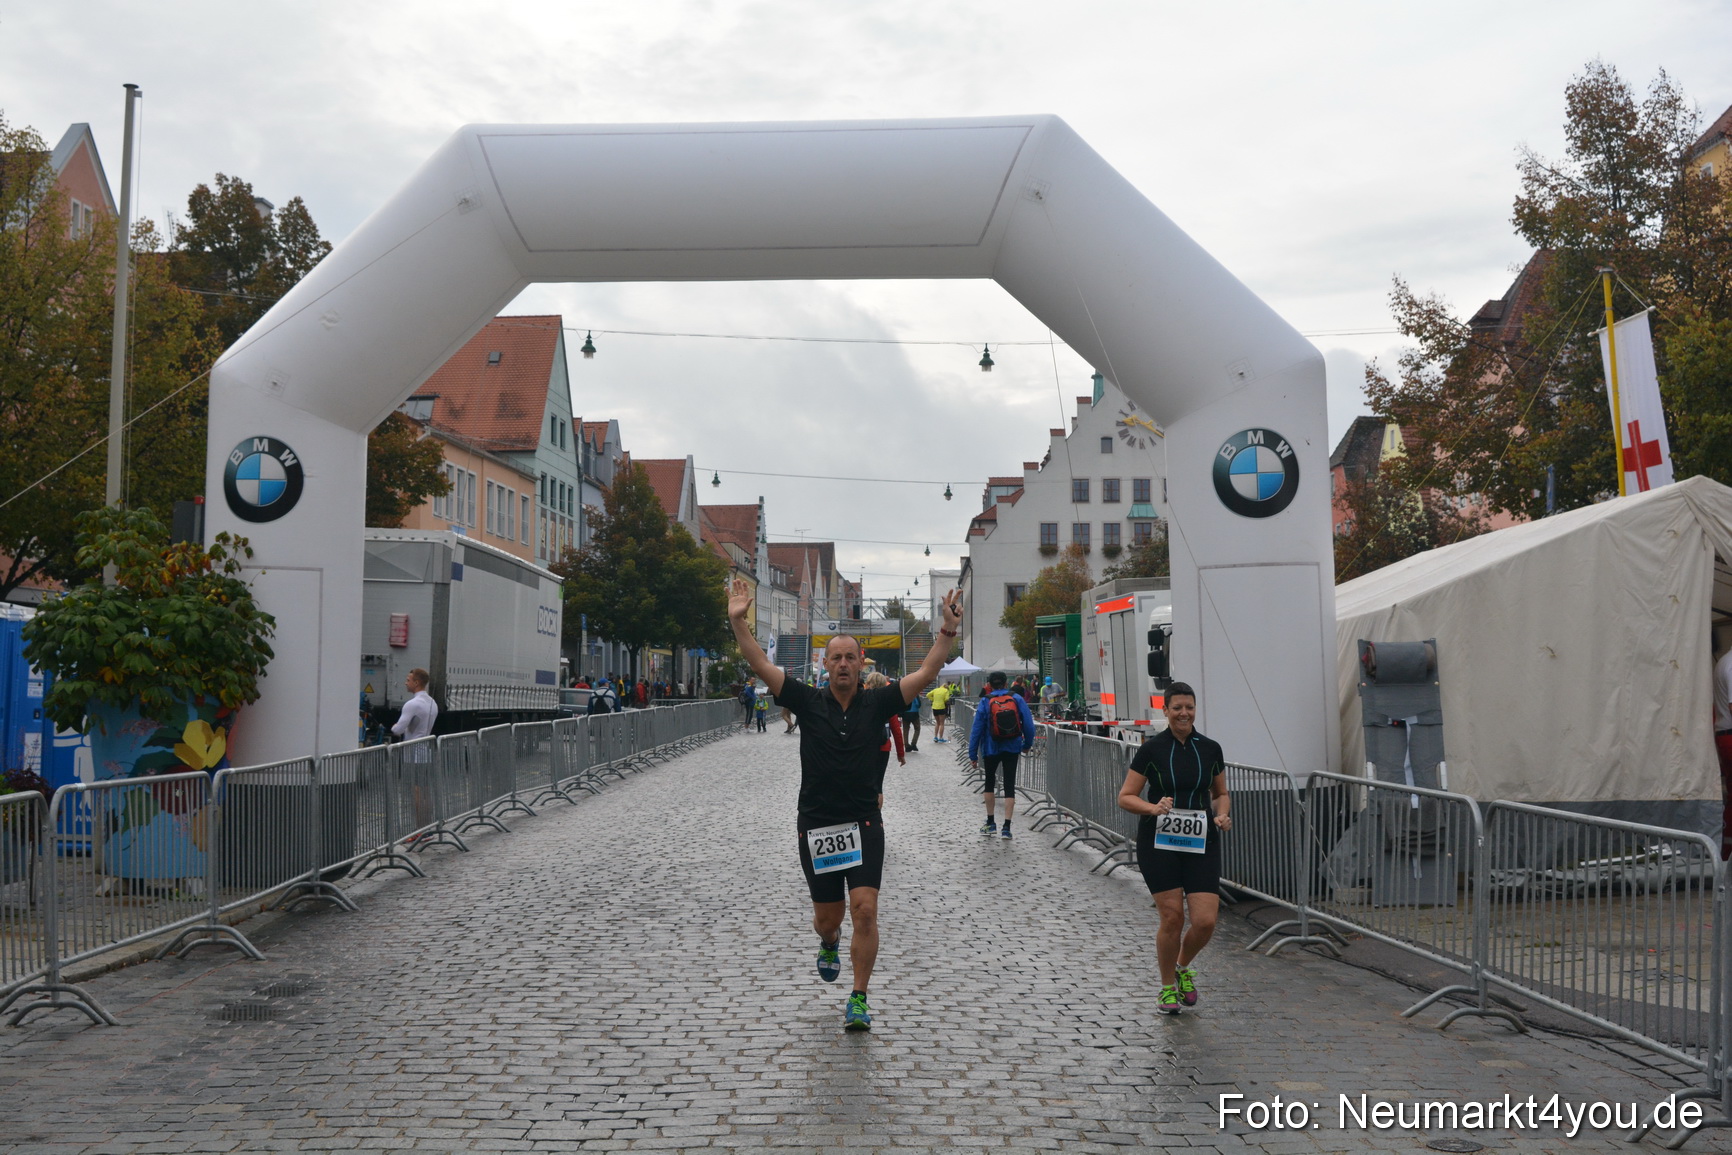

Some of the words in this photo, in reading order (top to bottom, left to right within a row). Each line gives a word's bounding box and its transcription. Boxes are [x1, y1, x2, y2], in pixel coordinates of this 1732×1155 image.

[229, 437, 299, 468] BMW
[1219, 430, 1293, 460] BMW
[1162, 817, 1203, 836] 2380
[814, 832, 855, 856] 2381
[1168, 837, 1192, 846] Kerstin
[823, 855, 854, 866] Wolfgang
